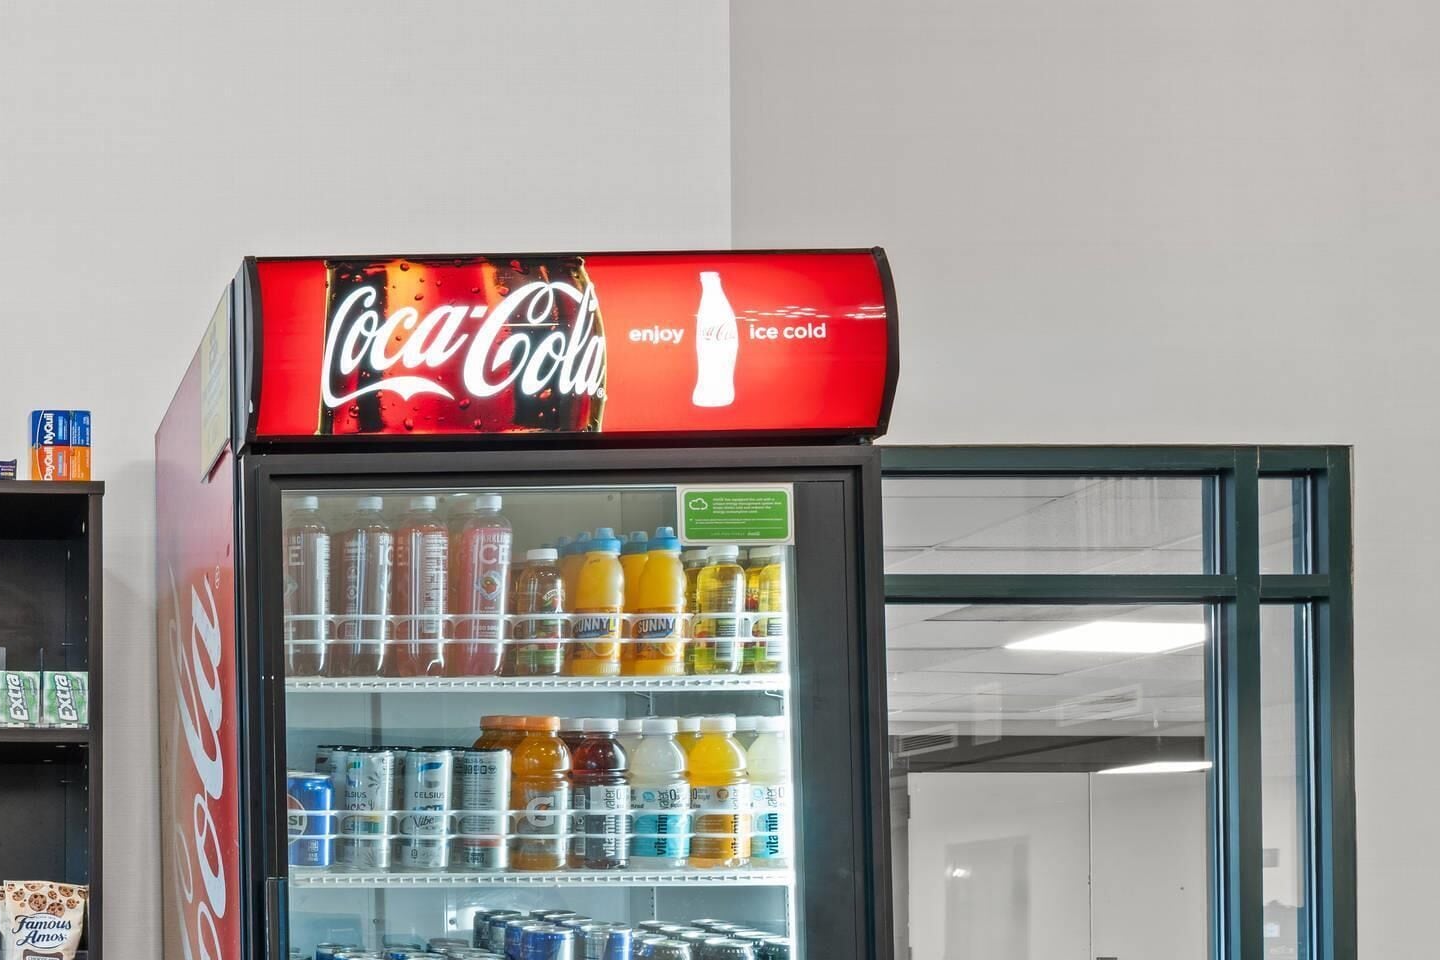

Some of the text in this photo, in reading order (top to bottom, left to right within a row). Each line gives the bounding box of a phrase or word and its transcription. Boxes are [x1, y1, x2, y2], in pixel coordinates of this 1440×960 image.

[323, 282, 604, 407] Coca-Cola
[628, 325, 684, 344] enjoy
[749, 323, 779, 339] ice
[782, 322, 827, 339] cold
[43, 413, 56, 445] NyQuil
[43, 447, 56, 480] DayQuil
[6, 673, 30, 722] Extra
[54, 673, 79, 722] Extra
[11, 915, 72, 934] Famous
[16, 930, 65, 946] Amos
